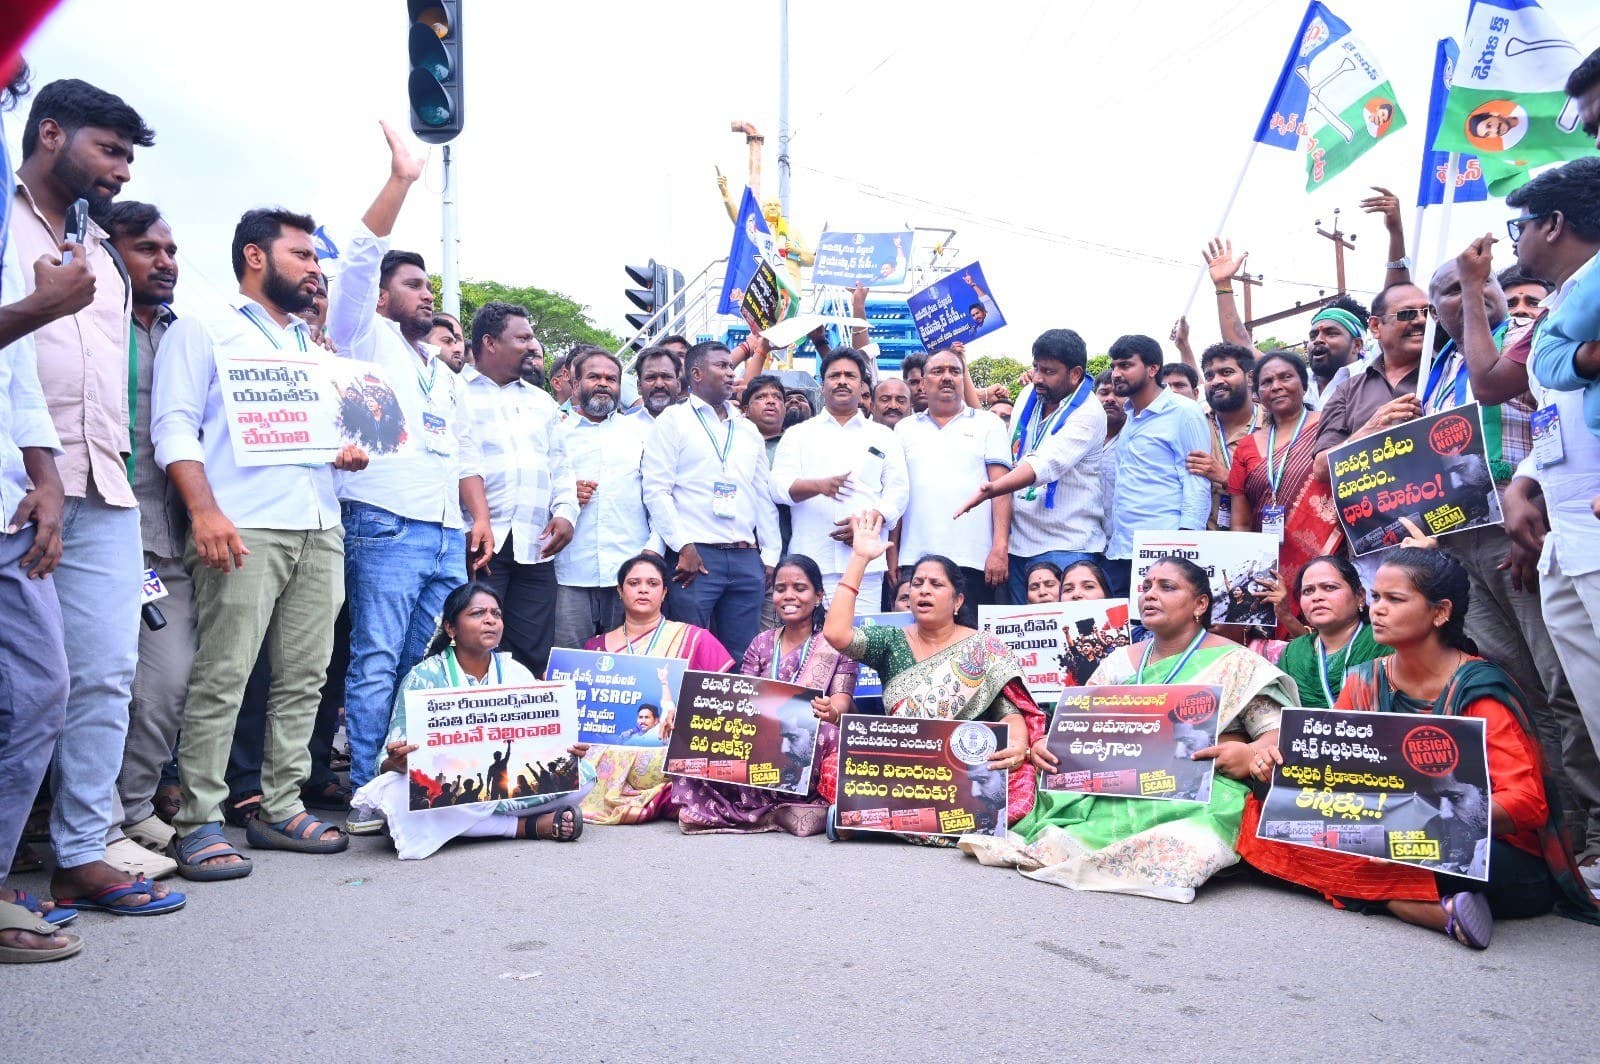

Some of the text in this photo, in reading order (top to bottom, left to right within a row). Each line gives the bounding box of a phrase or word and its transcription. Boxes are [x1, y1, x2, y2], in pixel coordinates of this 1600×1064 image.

[228, 366, 309, 387] నిరుద్యోగ
[233, 388, 319, 402] యువతకు
[237, 409, 308, 428] న్యాయం
[242, 428, 310, 445] చేయాలి
[1433, 421, 1467, 440] RESIGN
[1436, 430, 1469, 450] NOW!
[1334, 436, 1414, 477] టాపర్ల ఐడీలు
[1337, 470, 1396, 499] మాయం..
[1343, 473, 1446, 526] భారీ మోసం!
[1433, 511, 1461, 530] SCAM
[1005, 637, 1057, 650] కాయిలు
[591, 688, 642, 704] YSRCP
[733, 679, 759, 696] లేదు..
[427, 700, 456, 714] ఫీజు
[693, 696, 734, 715] మార్కులు
[1179, 703, 1213, 717] NOW!
[428, 708, 559, 729] వసతి దీవెన బకాయిలు
[690, 714, 725, 732] మెరిట్
[1057, 719, 1161, 735] బాబు జమానాలో
[1303, 718, 1373, 738] నేతల చేతిలో
[427, 726, 484, 747] వెంటనే
[487, 723, 562, 744] చెల్లించాలి
[900, 738, 943, 752] ఎందుకు?
[1069, 737, 1142, 762] ఉద్యోగాలు
[1408, 739, 1451, 752] RESIGN
[1411, 750, 1454, 766] NOW!
[845, 757, 953, 782] సీబీఐ విచారణకు
[1282, 765, 1405, 789] అర్హులైన క్రీడాకారులకు
[844, 780, 958, 804] భయం ఎందుకు?
[1144, 779, 1173, 792] SCAM
[944, 817, 971, 830] SCAM
[1395, 842, 1434, 857] SCAM
